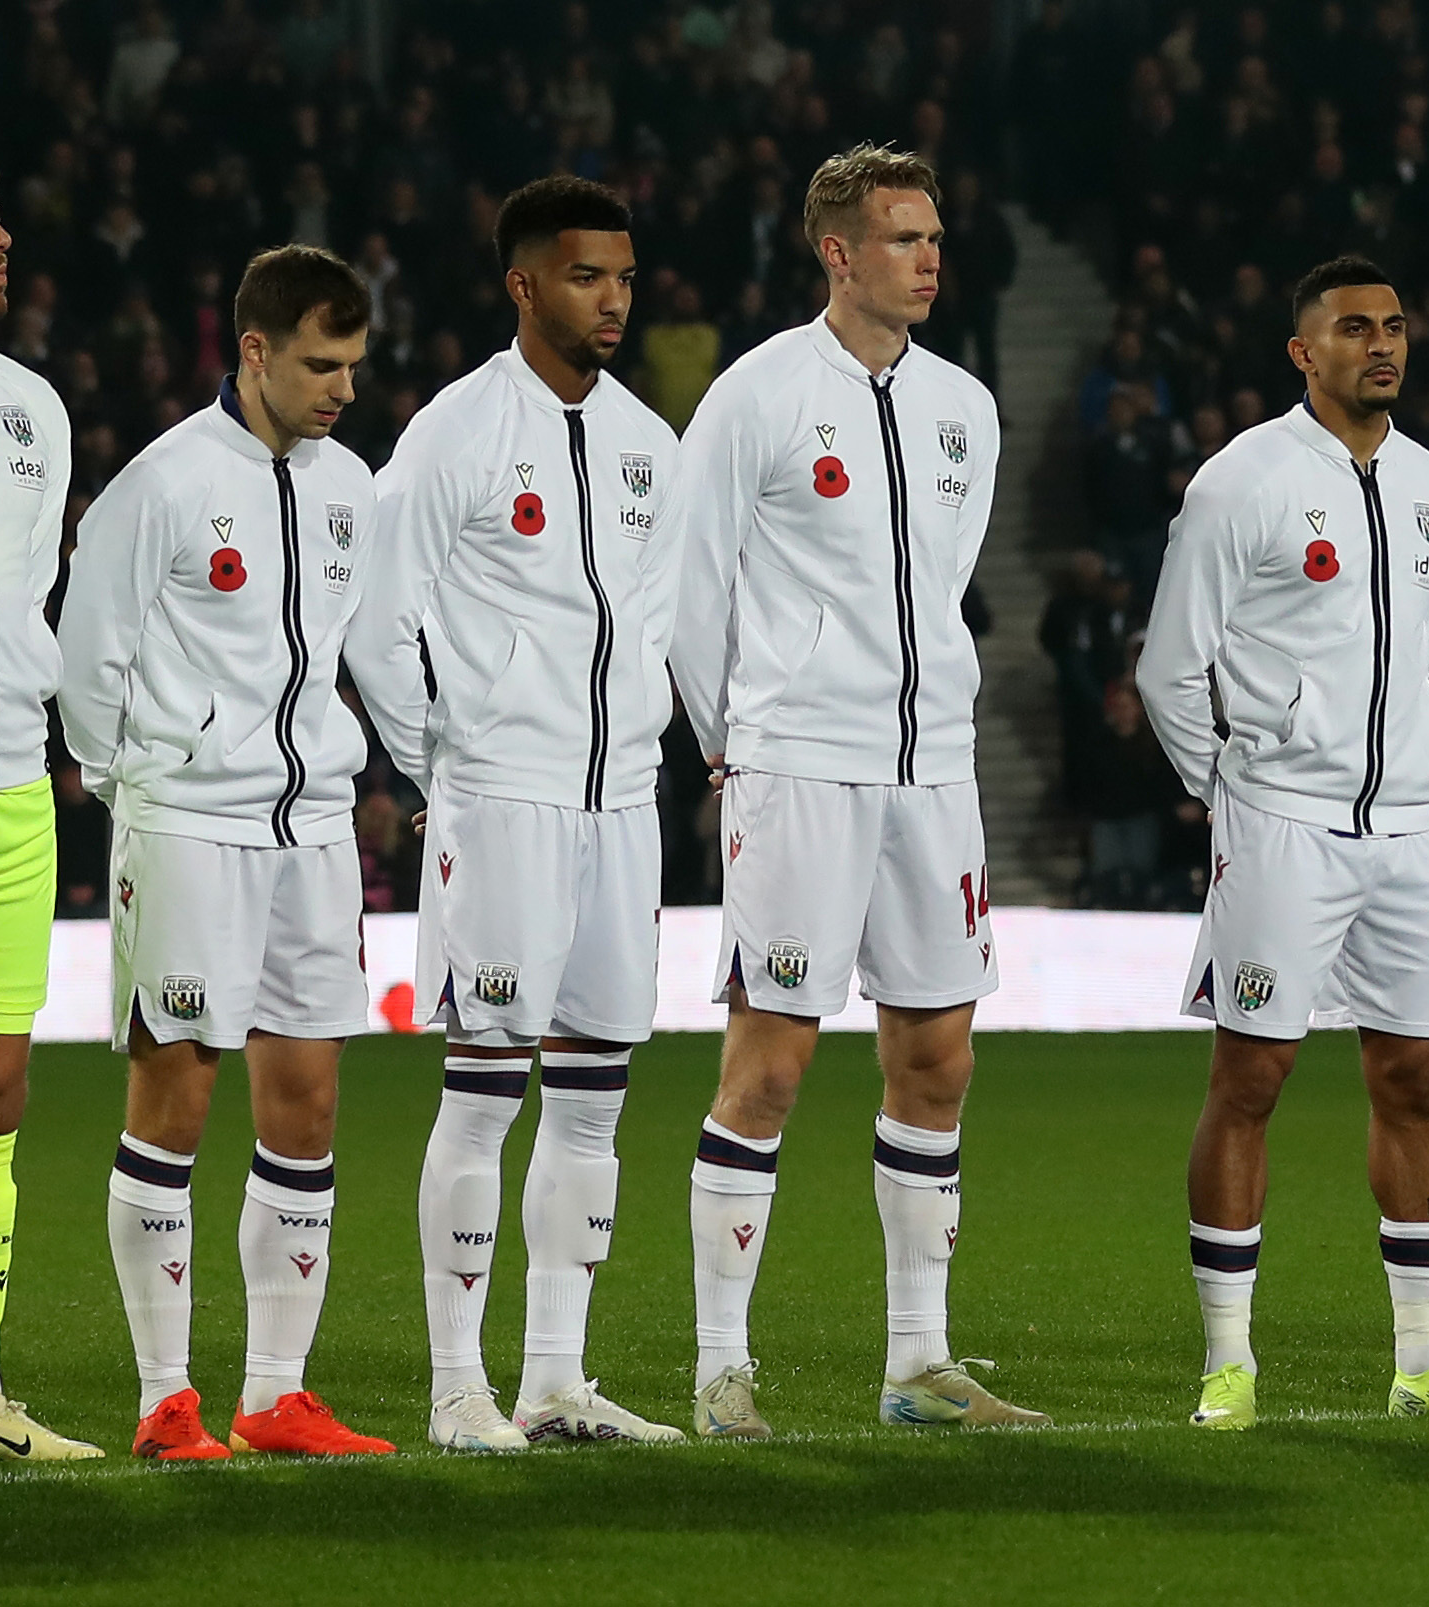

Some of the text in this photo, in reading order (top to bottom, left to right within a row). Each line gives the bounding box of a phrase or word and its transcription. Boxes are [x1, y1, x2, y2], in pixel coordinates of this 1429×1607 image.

[769, 946, 807, 959] ALBION
[478, 967, 516, 980] ALBION
[1239, 967, 1274, 984] ALBION
[164, 982, 203, 992] ALBION
[140, 1218, 186, 1233] WBA
[277, 1213, 331, 1229] WBA
[451, 1230, 493, 1246] WBA
